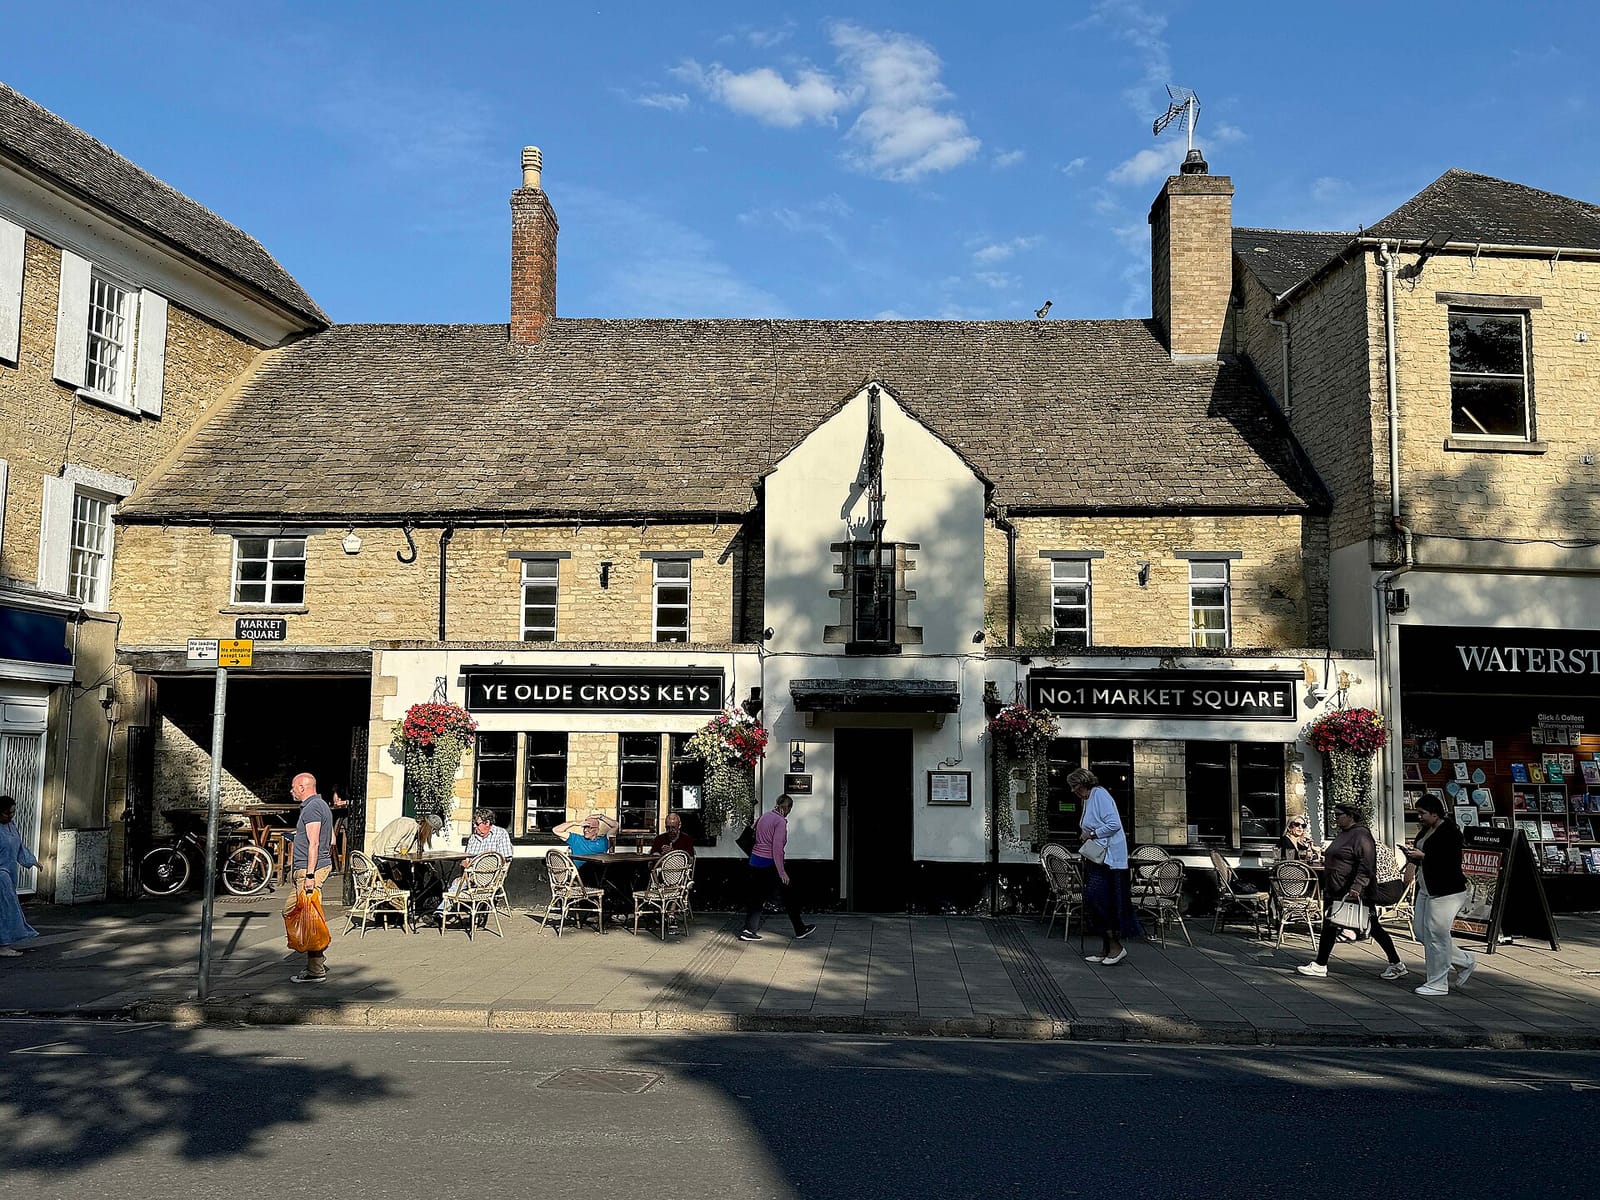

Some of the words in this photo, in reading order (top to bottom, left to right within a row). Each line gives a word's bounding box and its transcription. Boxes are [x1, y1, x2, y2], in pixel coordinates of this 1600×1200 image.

[240, 620, 282, 629] MARKET
[241, 630, 280, 640] SQUARE
[482, 684, 507, 700] YE
[514, 684, 573, 701] OLDE
[580, 685, 650, 701] CROSS
[658, 686, 710, 701] KEYS
[1040, 688, 1085, 704] No.1
[1092, 689, 1185, 706] MARKET
[1192, 690, 1284, 709] SQUARE
[1462, 853, 1498, 866] SUMMER
